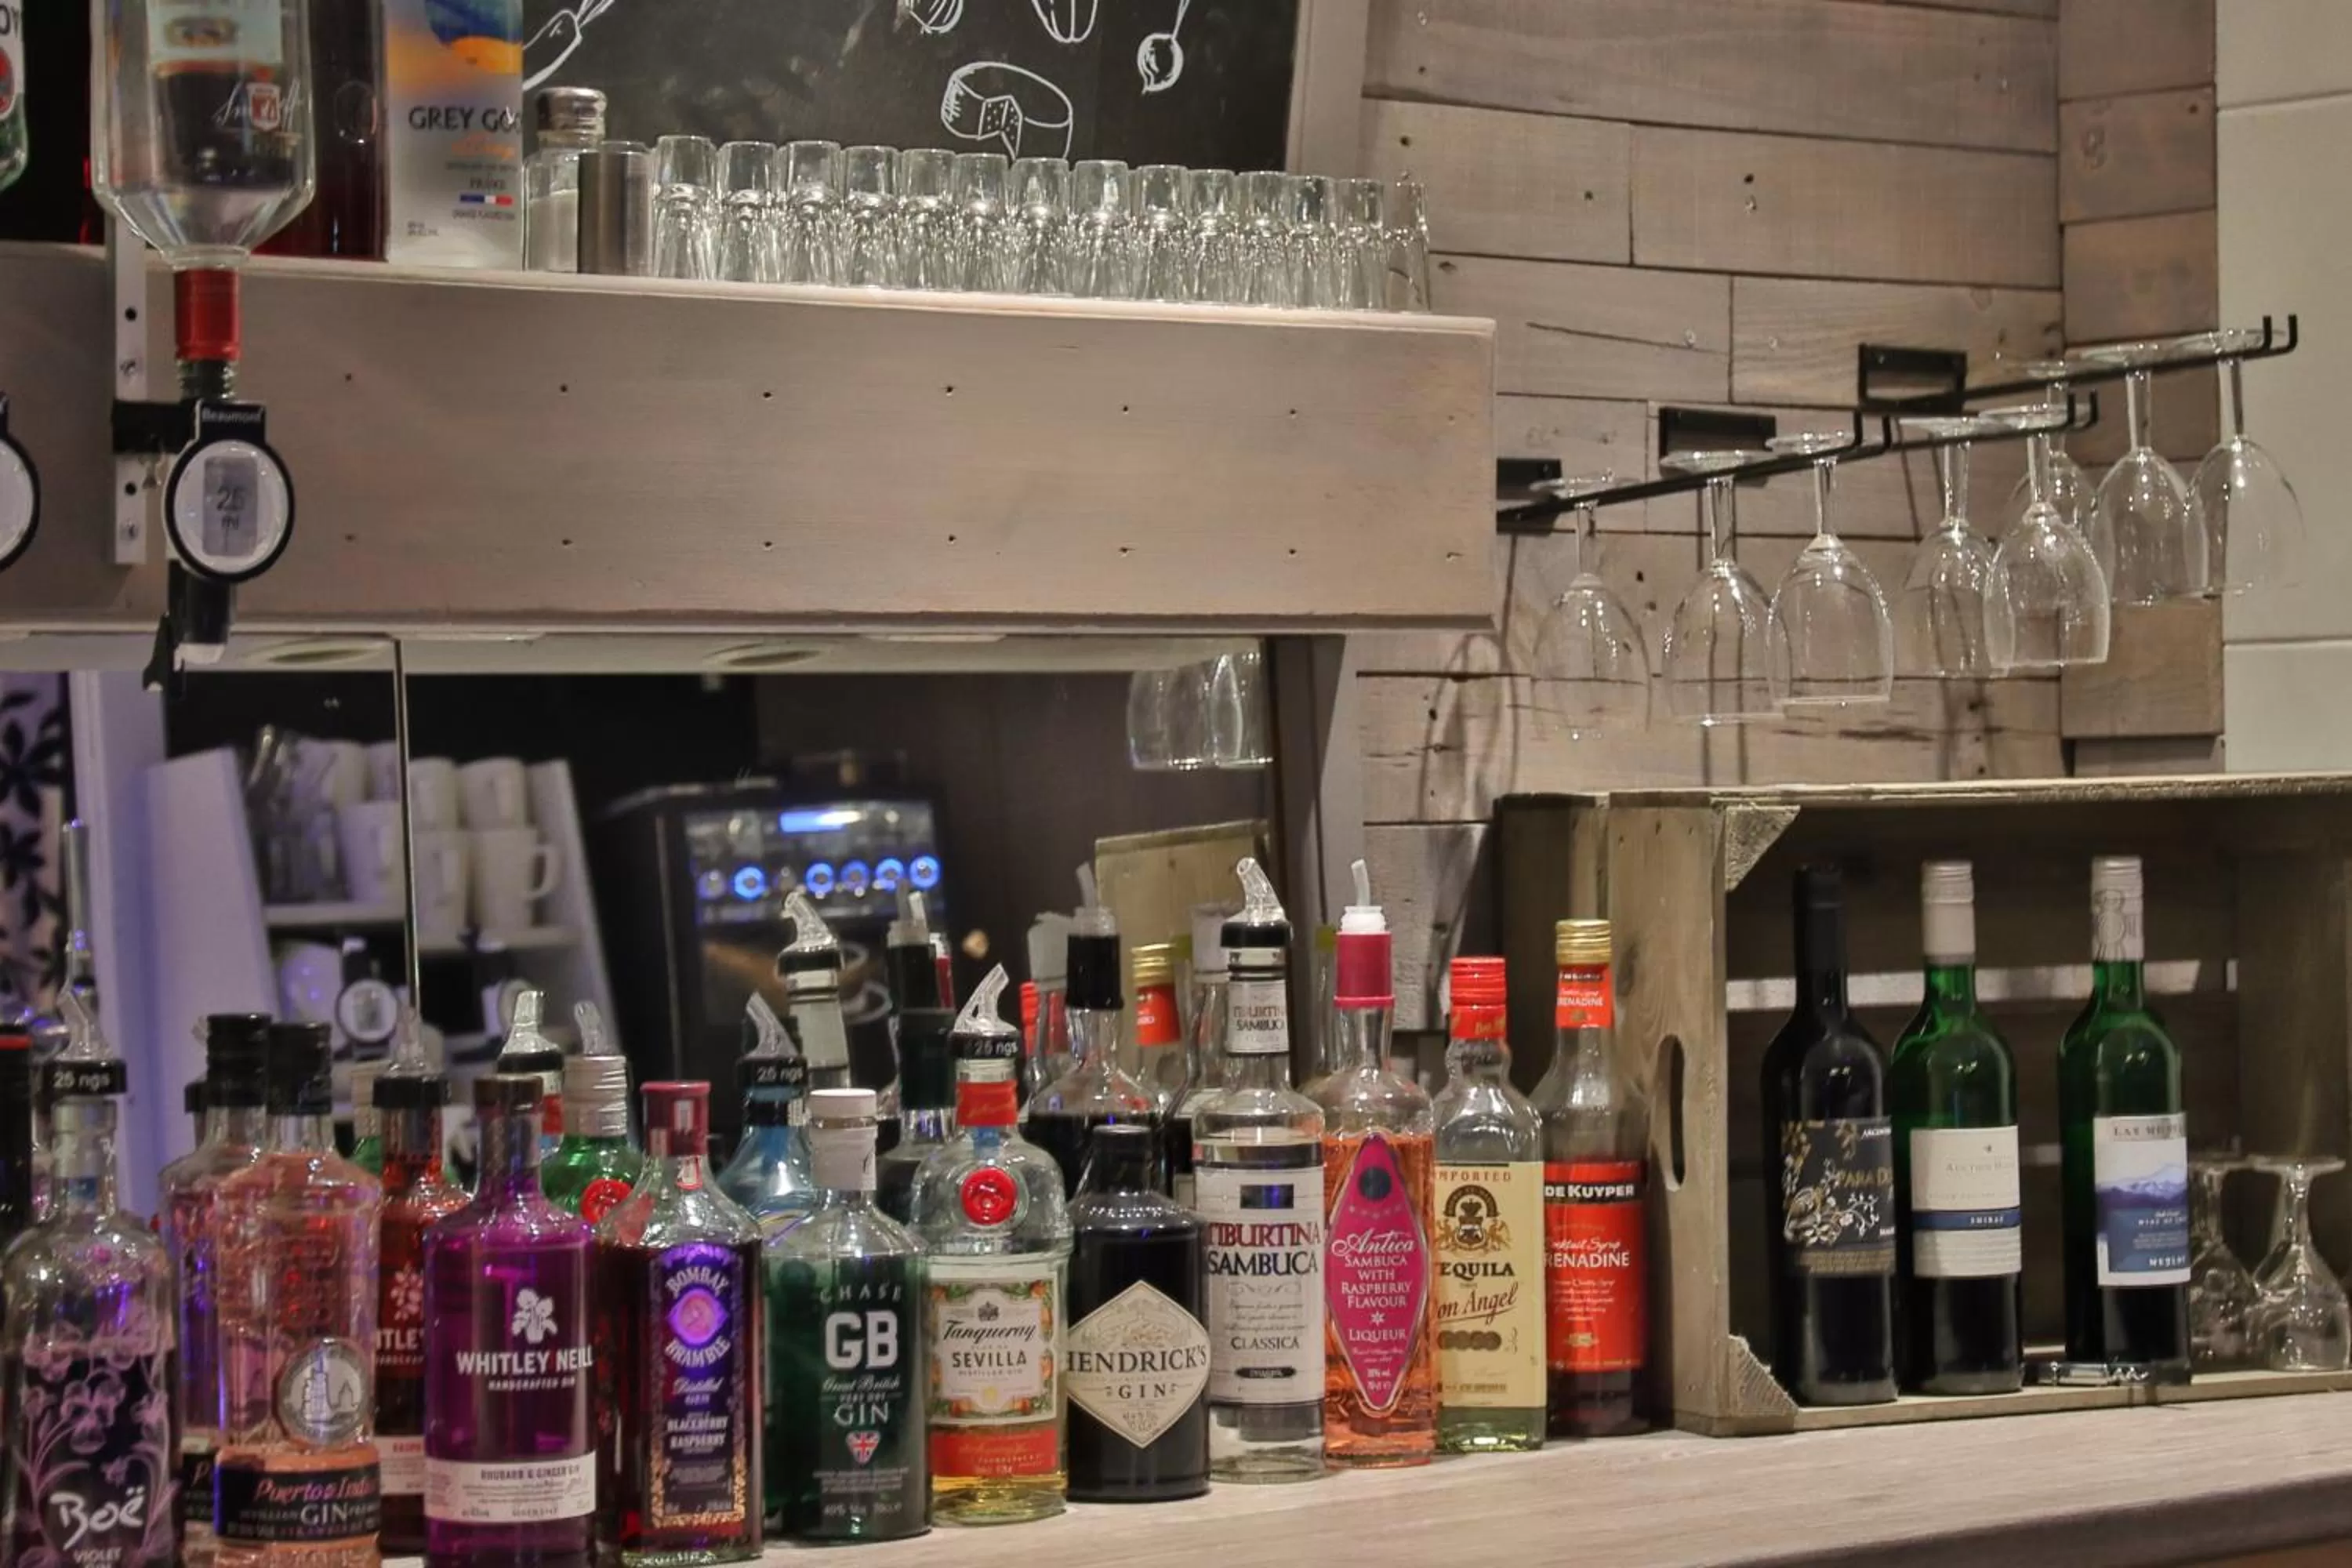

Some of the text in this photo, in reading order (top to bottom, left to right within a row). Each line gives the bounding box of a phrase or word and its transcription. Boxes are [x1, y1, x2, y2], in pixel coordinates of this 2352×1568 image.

[408, 106, 474, 130] GREY
[1439, 1171, 1512, 1182] MPORTED
[1544, 1184, 1635, 1198] DE KUYPER
[1207, 1221, 1321, 1247] TIBURTINA
[1331, 1228, 1414, 1257] Antica
[1207, 1250, 1318, 1276] SAMBUCA
[1345, 1255, 1408, 1267] SAMBUCA
[1439, 1262, 1515, 1281] EQUILA
[666, 1266, 729, 1299] BOMBAY
[1357, 1269, 1395, 1280] WITH
[820, 1283, 902, 1304] CHASE
[1341, 1281, 1412, 1294] RASPBERRY
[1347, 1295, 1406, 1308] FLAVOUR
[1437, 1301, 1459, 1319] on
[1461, 1281, 1519, 1326] Angel
[826, 1310, 898, 1369] GB
[943, 1320, 1036, 1345] Tanqueray
[1231, 1336, 1300, 1350] CLASSICA
[1349, 1329, 1406, 1342] LIQUEUR
[456, 1345, 593, 1375] WHITLEY NEILL
[665, 1335, 731, 1367] BRAMBLE
[953, 1350, 1027, 1368] SEVILLA
[1118, 1384, 1166, 1399] GIN
[834, 1402, 889, 1427] GIN
[49, 1486, 145, 1551] Boë
[300, 1502, 349, 1526] GIN
[74, 1547, 122, 1563] VIOLET
